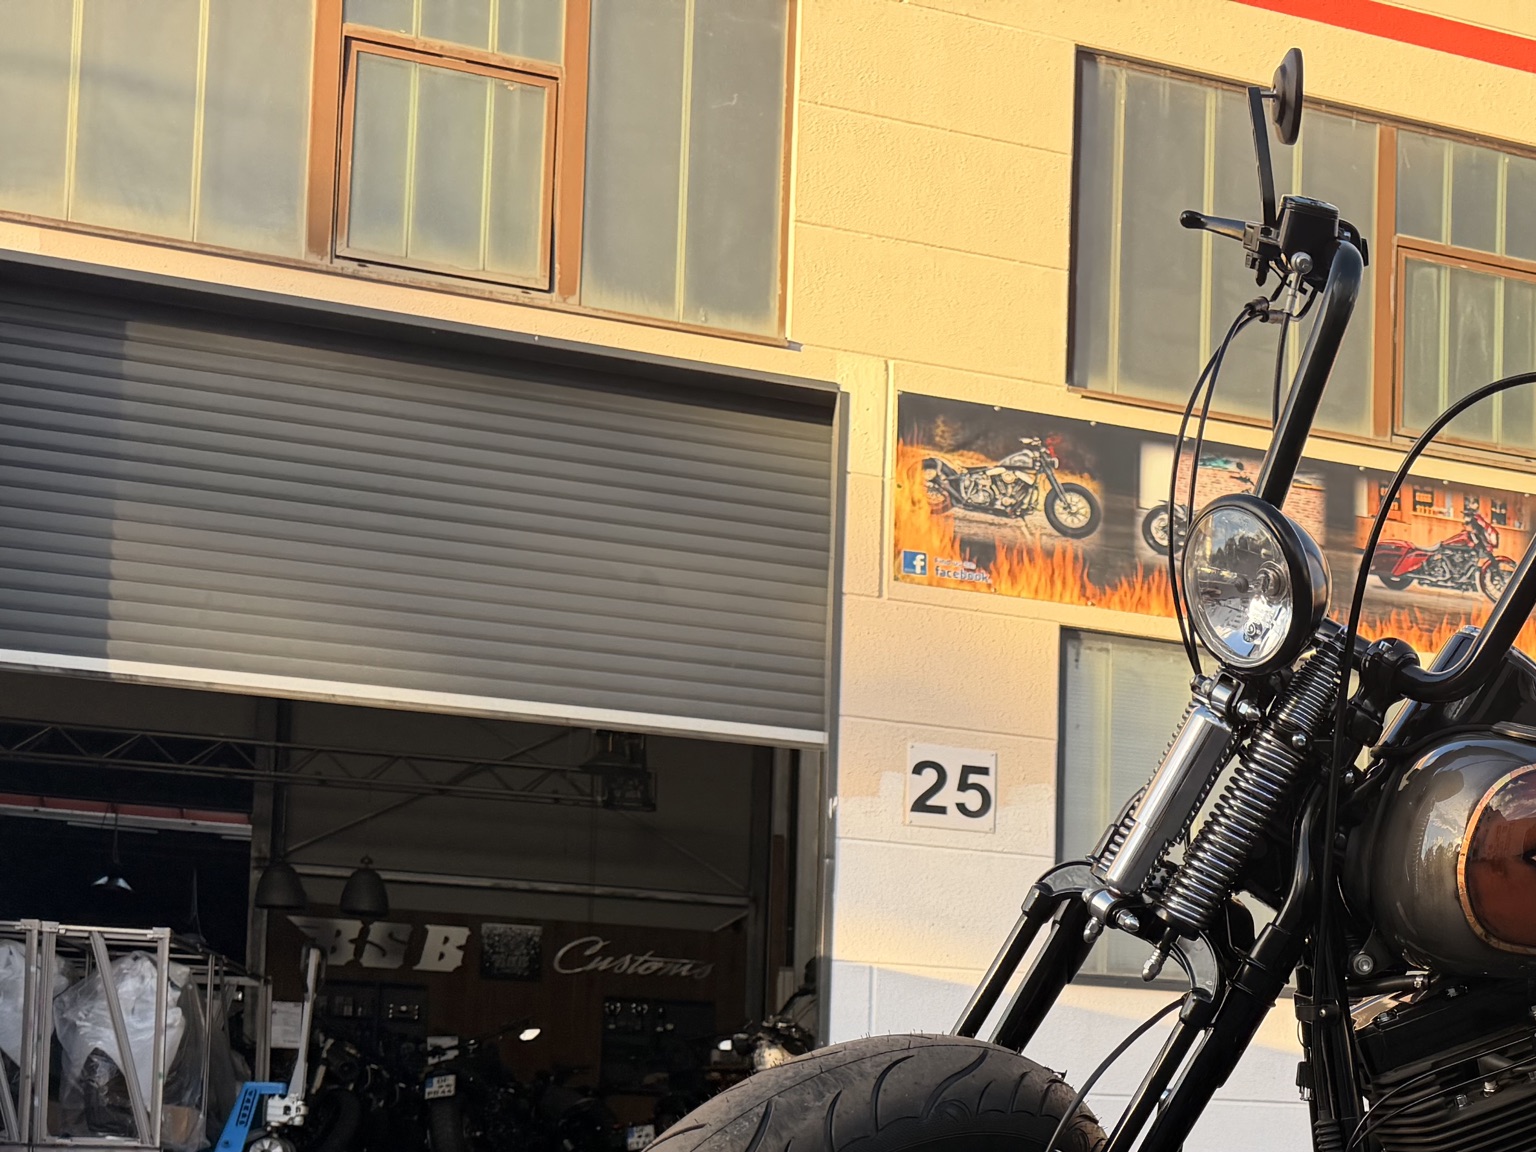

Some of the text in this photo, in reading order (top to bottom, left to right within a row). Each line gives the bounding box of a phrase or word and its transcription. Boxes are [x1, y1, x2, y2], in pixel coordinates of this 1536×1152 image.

[935, 565, 990, 583] facebook
[910, 760, 992, 818] 25
[287, 915, 716, 979] BSB Customs
